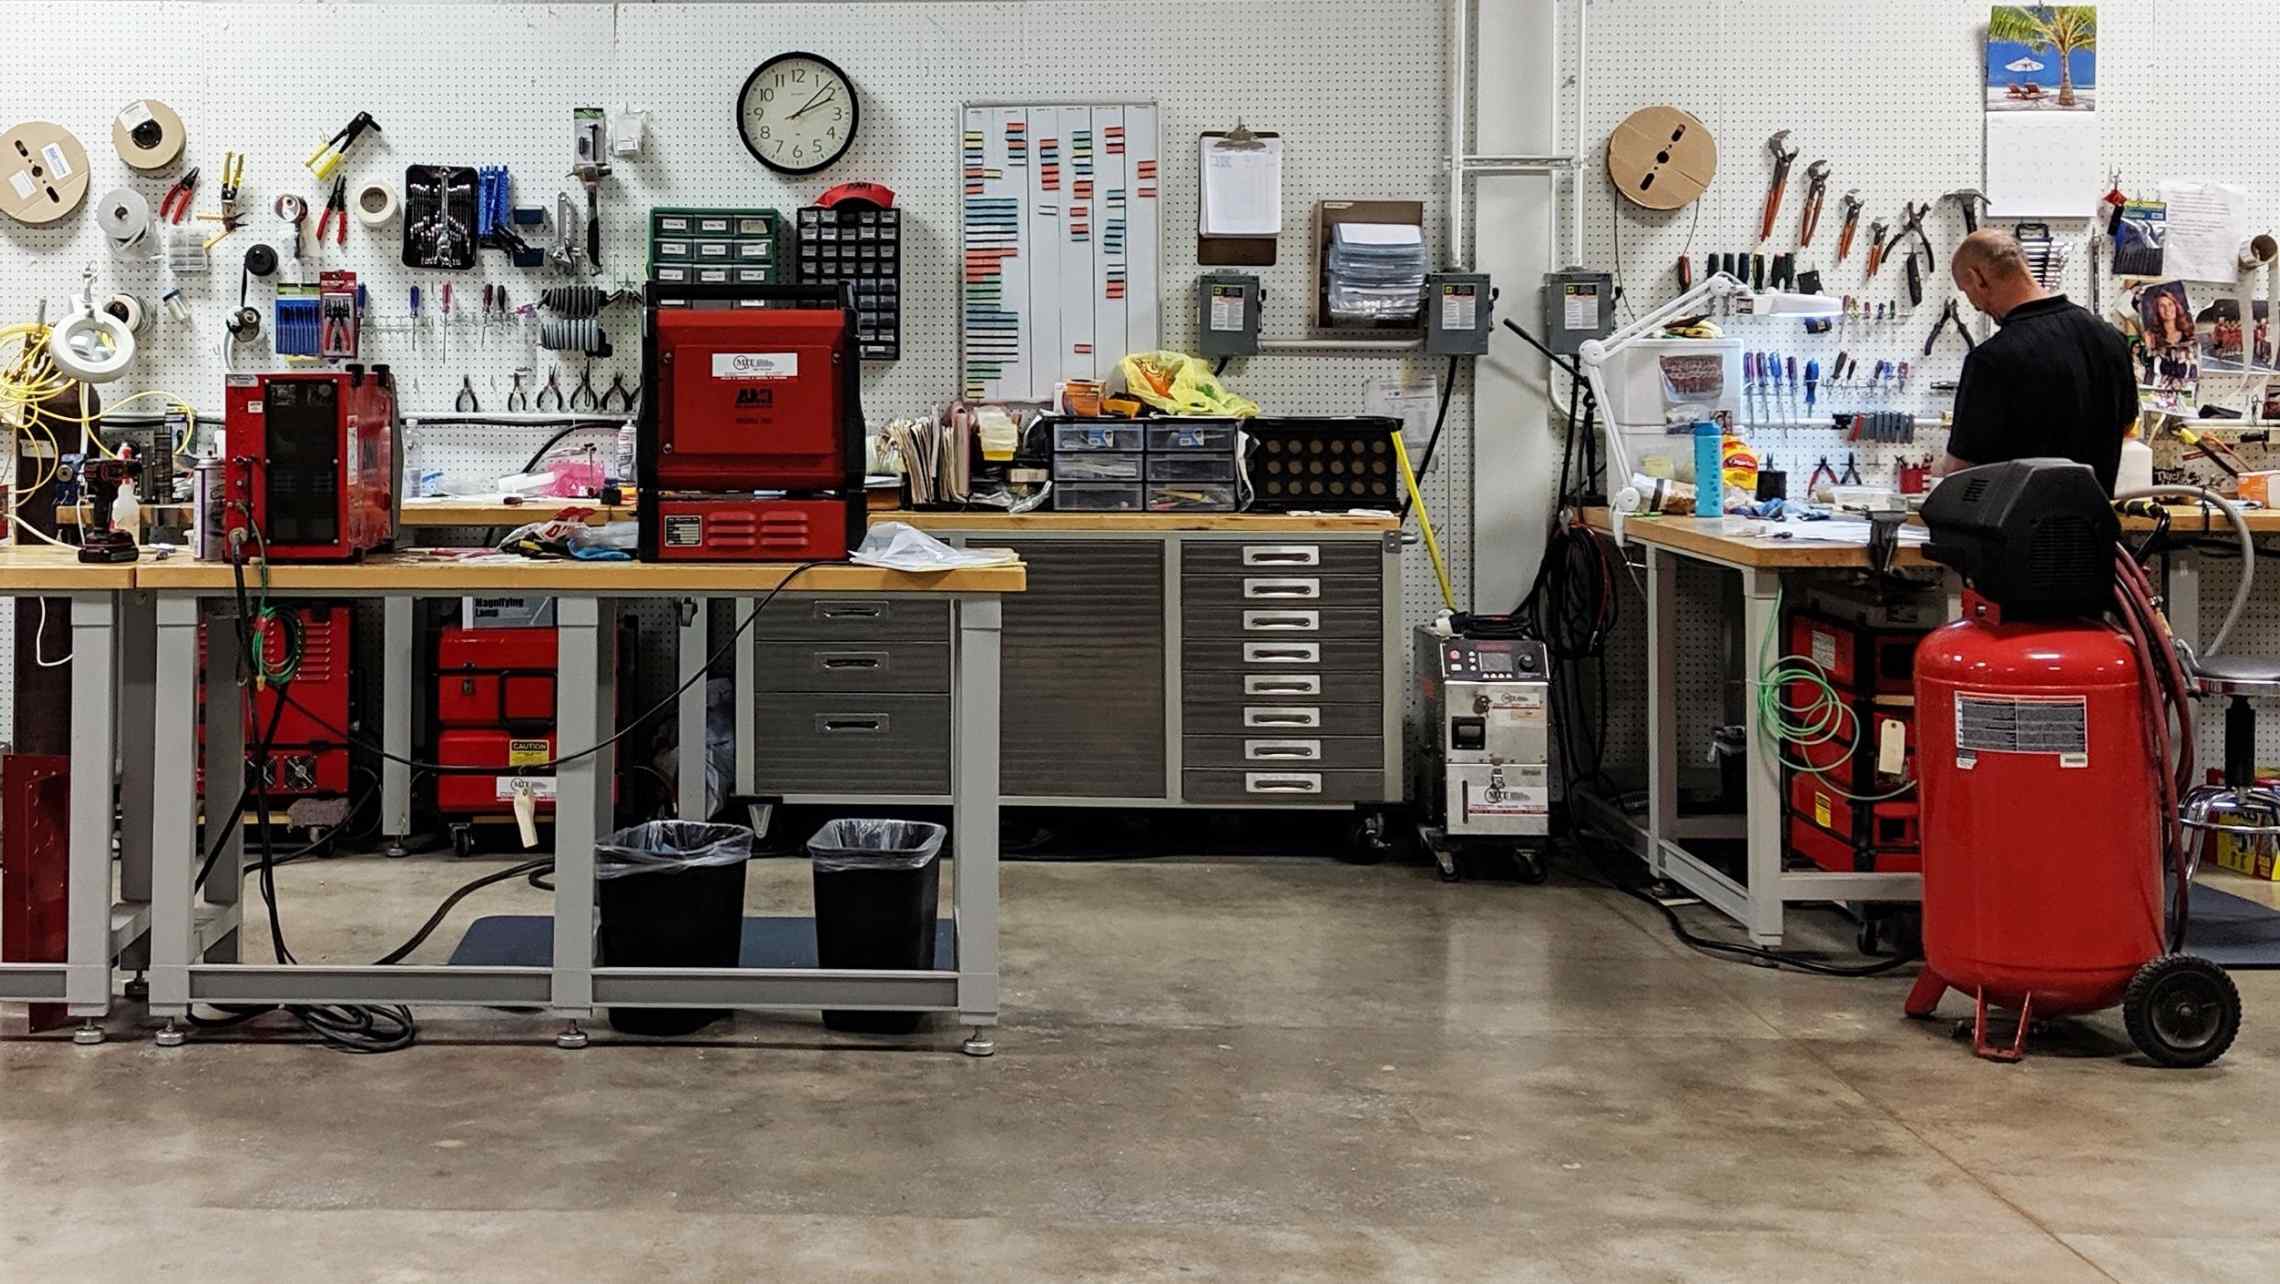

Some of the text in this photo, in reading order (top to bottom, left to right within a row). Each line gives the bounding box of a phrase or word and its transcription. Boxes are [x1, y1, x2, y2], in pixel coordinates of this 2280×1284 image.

[774, 73, 785, 88] 11
[791, 68, 806, 83] 12
[814, 73, 820, 88] 1
[759, 87, 775, 102] 10
[753, 107, 764, 121] 9
[832, 106, 842, 121] 3
[759, 125, 770, 140] 8
[826, 126, 836, 140] 4
[775, 139, 785, 154] 7
[792, 144, 803, 159] 6
[812, 139, 823, 153] 5
[475, 598, 524, 609] Magnifying
[475, 608, 498, 618] Lamp
[513, 742, 546, 751] CAUTION
